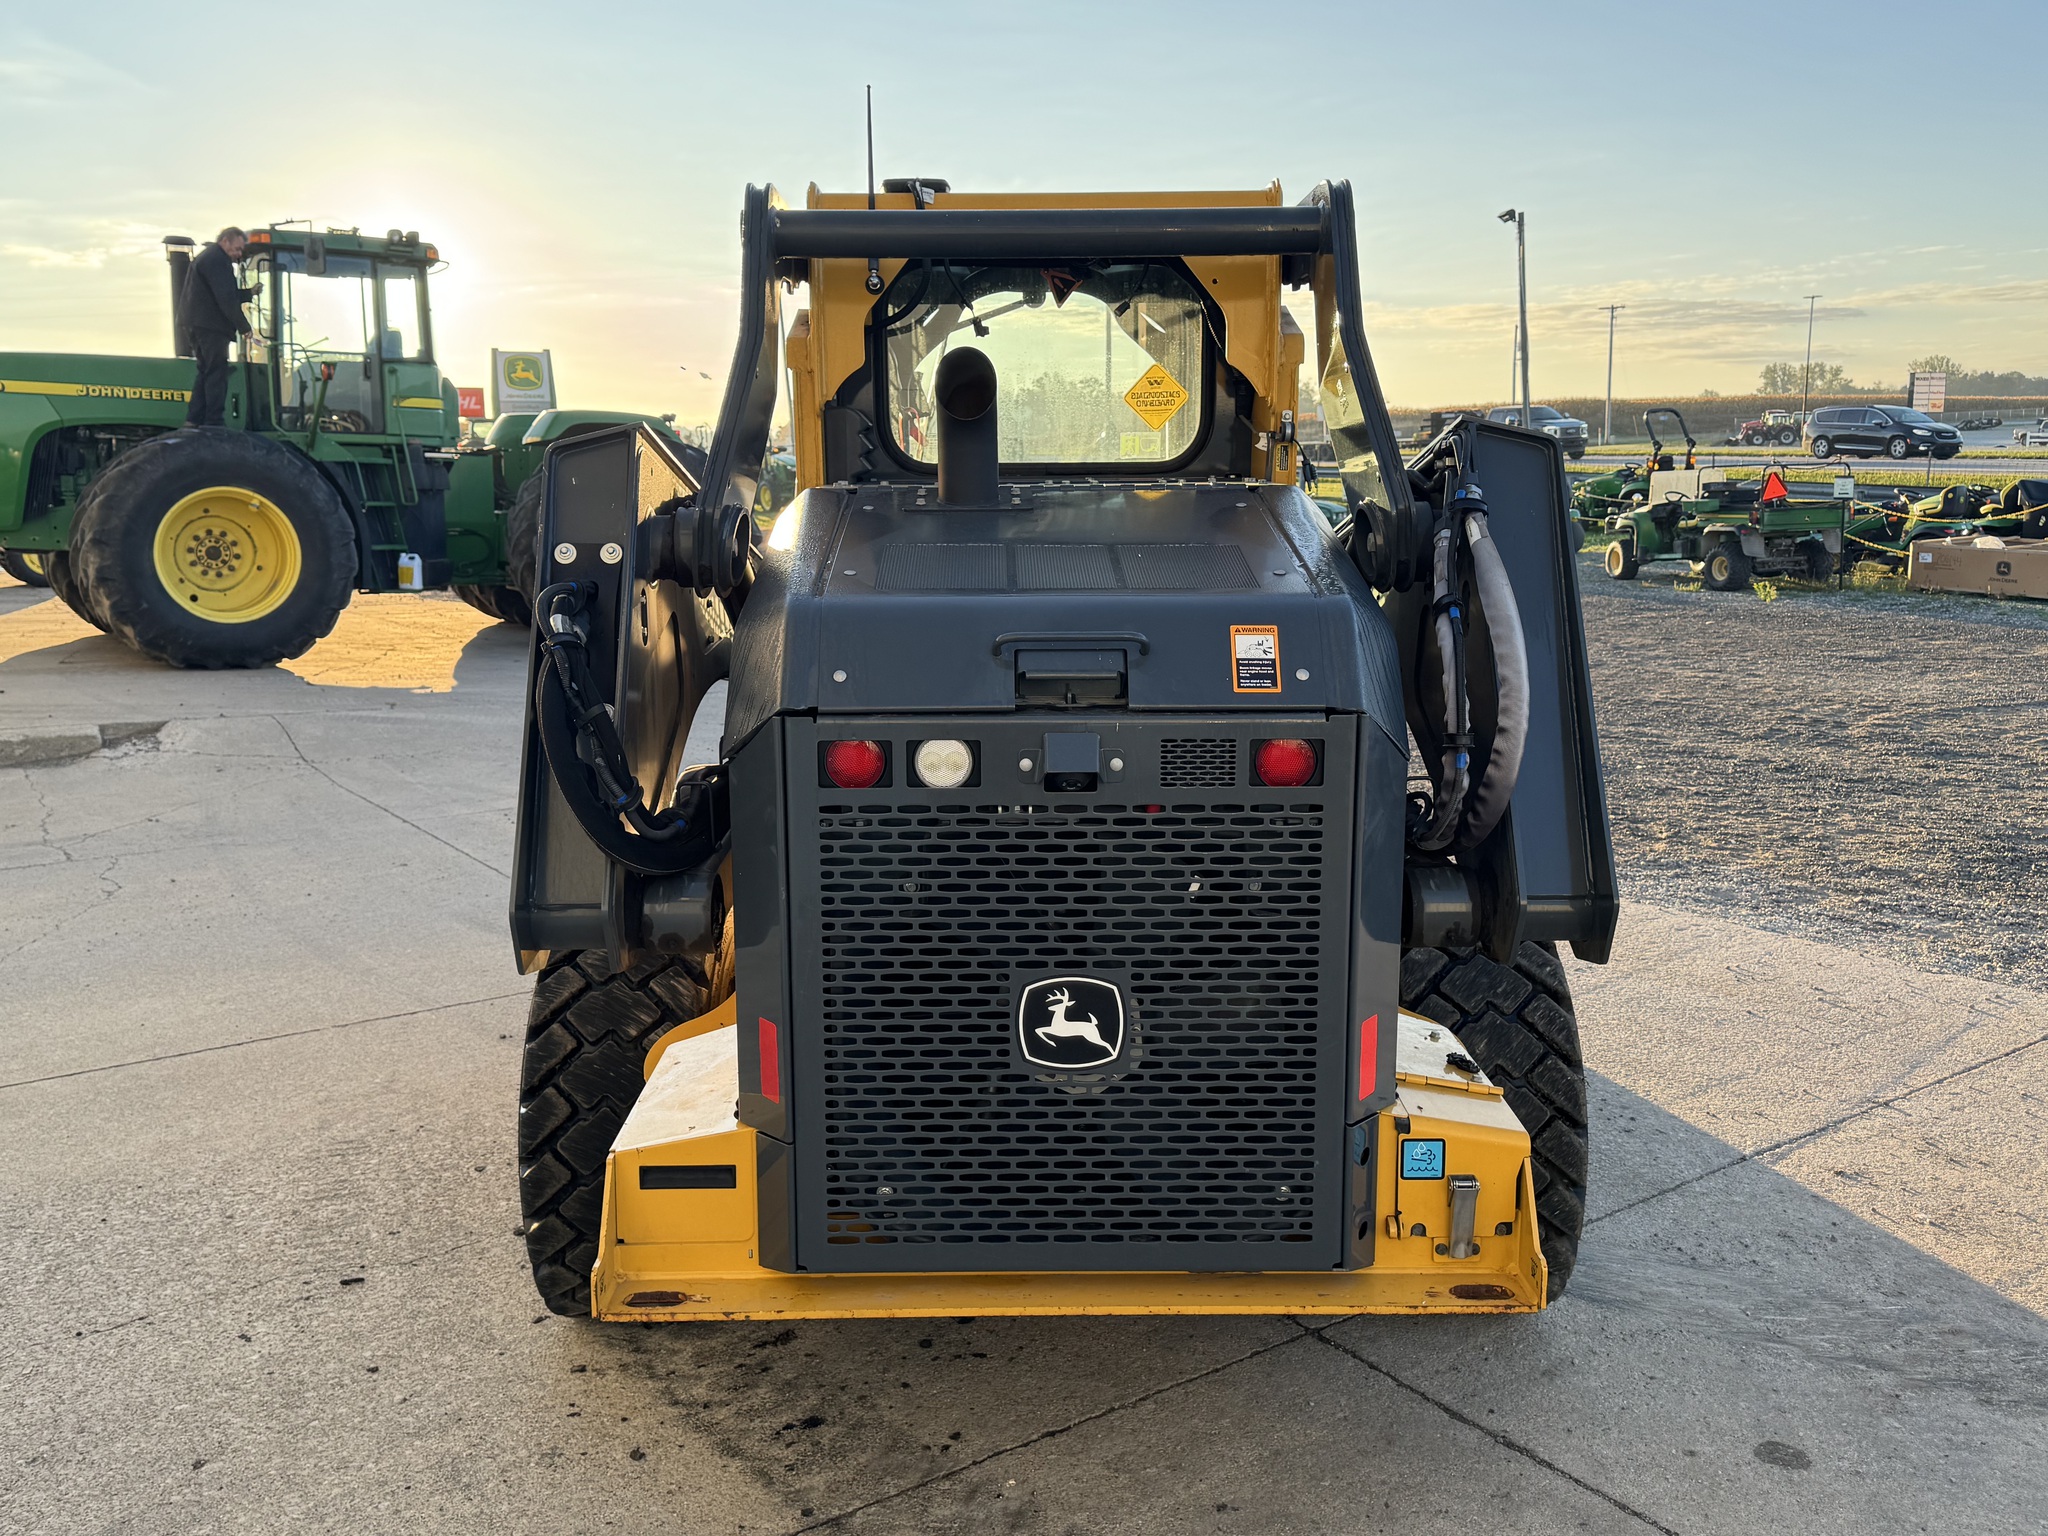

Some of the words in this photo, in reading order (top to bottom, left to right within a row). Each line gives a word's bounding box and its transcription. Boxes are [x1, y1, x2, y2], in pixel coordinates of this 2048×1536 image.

[77, 384, 126, 398] JOHN
[128, 387, 184, 401] DEERE
[1131, 390, 1180, 400] DIAGNOSTICS
